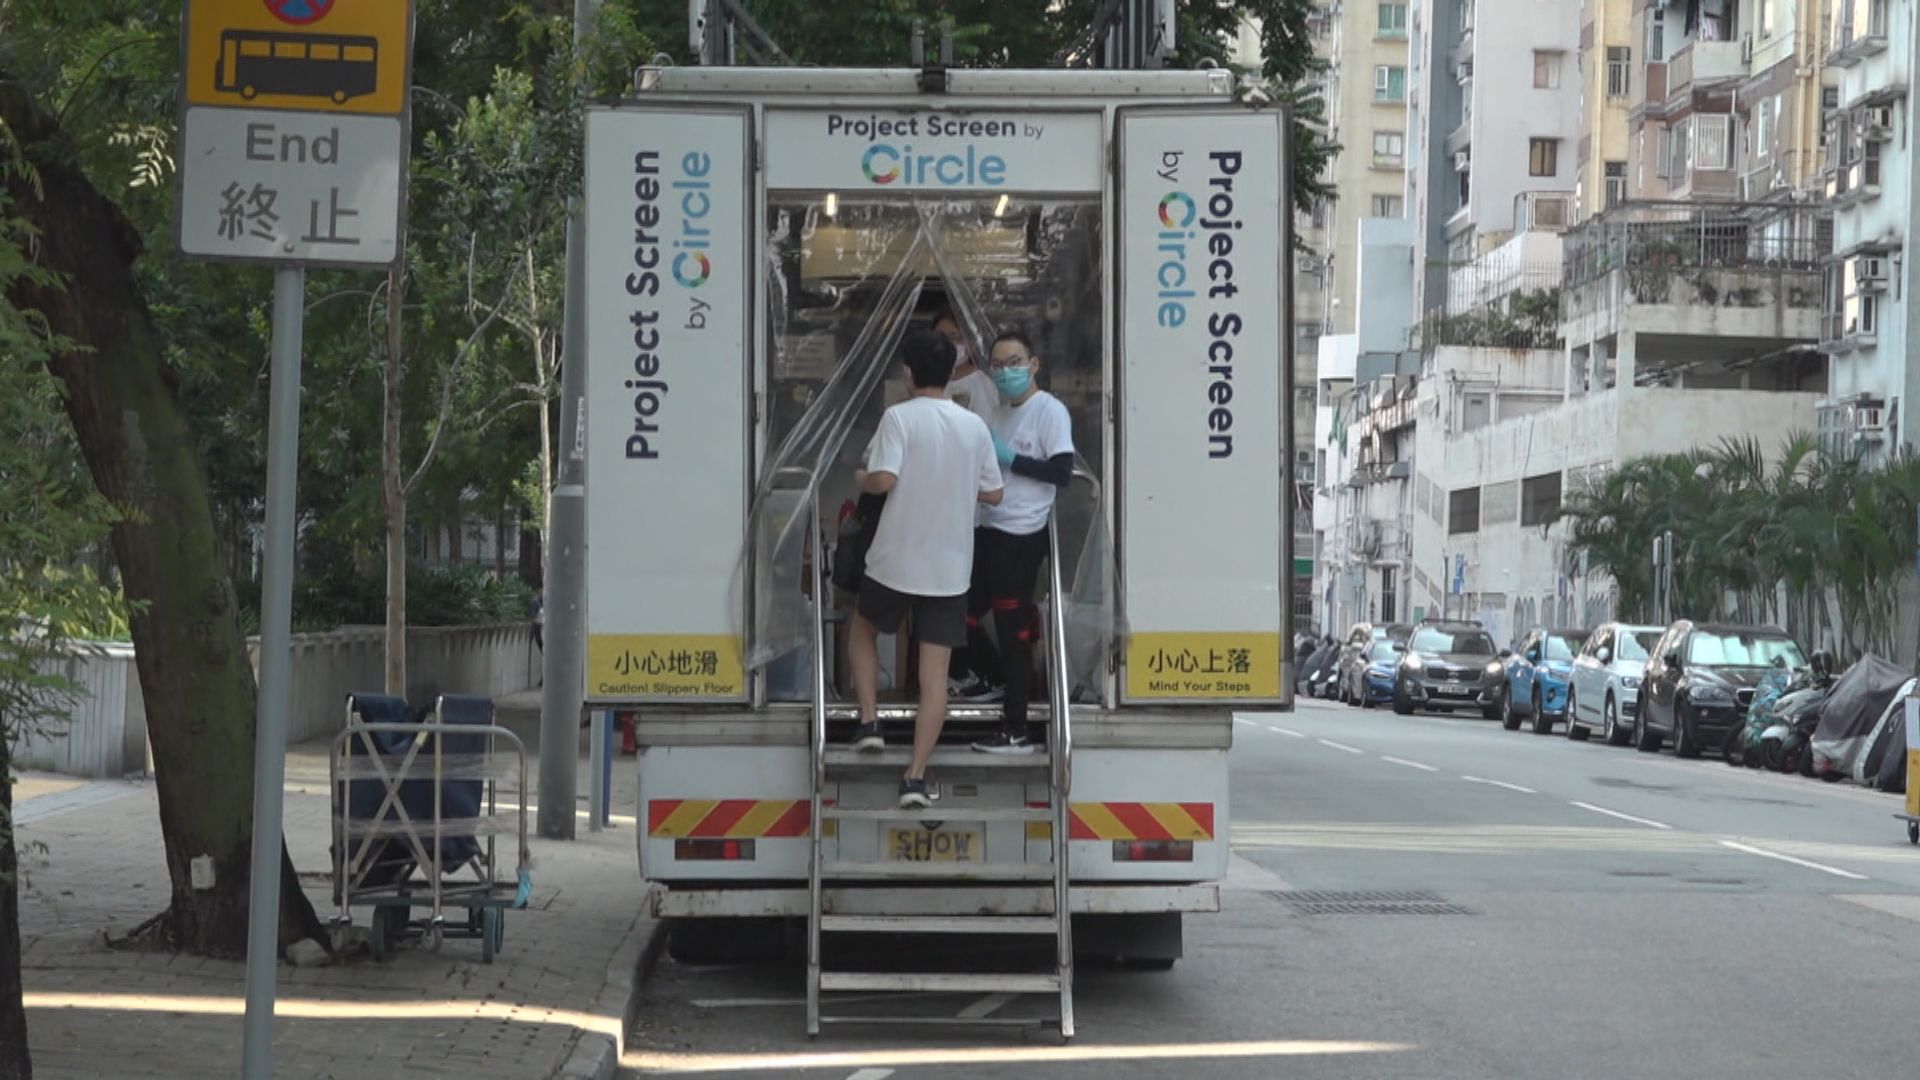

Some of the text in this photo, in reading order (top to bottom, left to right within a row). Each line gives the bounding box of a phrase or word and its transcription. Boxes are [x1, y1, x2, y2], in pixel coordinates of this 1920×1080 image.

[246, 123, 339, 164] End
[828, 114, 1044, 141] Project Screen by
[861, 143, 1006, 185] Circle
[217, 181, 361, 245] 終止
[671, 151, 711, 329] by Circle
[1156, 151, 1196, 328] by Circle
[625, 151, 668, 459] Project Screen
[1199, 151, 1242, 459] Project Screen
[614, 650, 718, 675] 小心地滑
[1148, 648, 1251, 673] 小心上落
[599, 683, 734, 695] Caution! Slippery Floor
[1149, 681, 1251, 693] Mind Your Steps
